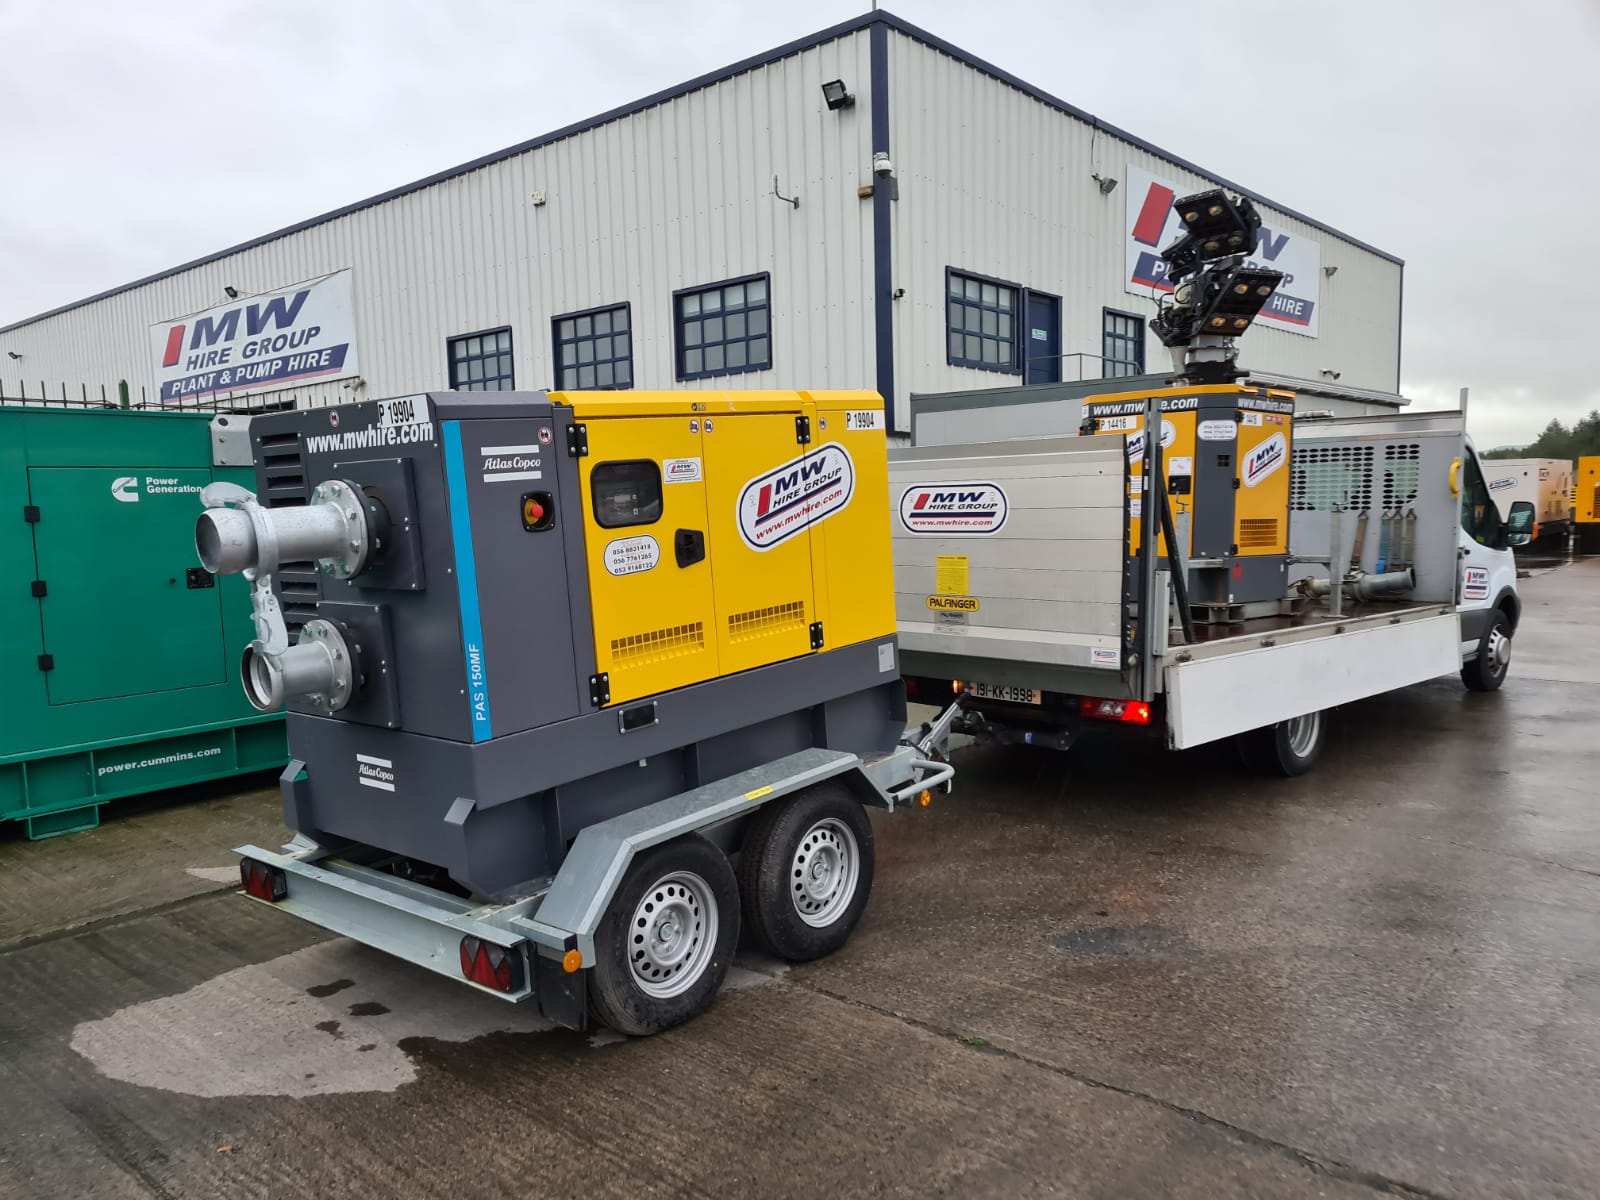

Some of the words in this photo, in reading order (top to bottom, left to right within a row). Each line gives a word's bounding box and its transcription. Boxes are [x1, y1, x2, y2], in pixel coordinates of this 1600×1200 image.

[1272, 296, 1304, 316] HIRE
[190, 289, 311, 350] MW
[186, 347, 232, 371] HIRE
[242, 326, 321, 359] GROUP
[172, 373, 216, 395] PLANT
[220, 371, 231, 384] &
[236, 360, 282, 382] PUMP
[288, 350, 332, 372] HIRE
[378, 404, 385, 425] P
[388, 400, 415, 424] 19904
[846, 412, 851, 428] P
[854, 412, 875, 428] 19904
[307, 422, 434, 454] www.mwhire.com
[483, 457, 513, 470] Atlas
[513, 456, 541, 470] Copco
[1255, 441, 1277, 464] MW
[146, 477, 179, 485] Power
[772, 488, 801, 509] HIRE
[803, 467, 842, 492] GROUP
[774, 456, 827, 495] MW
[146, 485, 202, 494] Generation
[931, 491, 986, 503] MW
[756, 489, 842, 540] www.mwhire.com
[929, 598, 976, 610] PALFINGER
[468, 644, 483, 688] 150MF
[976, 683, 1033, 702] 191-KK-1998
[473, 692, 487, 721] PAS
[98, 747, 221, 776] power.cummins.com
[358, 763, 376, 777] Atlas
[375, 767, 394, 781] Copco
